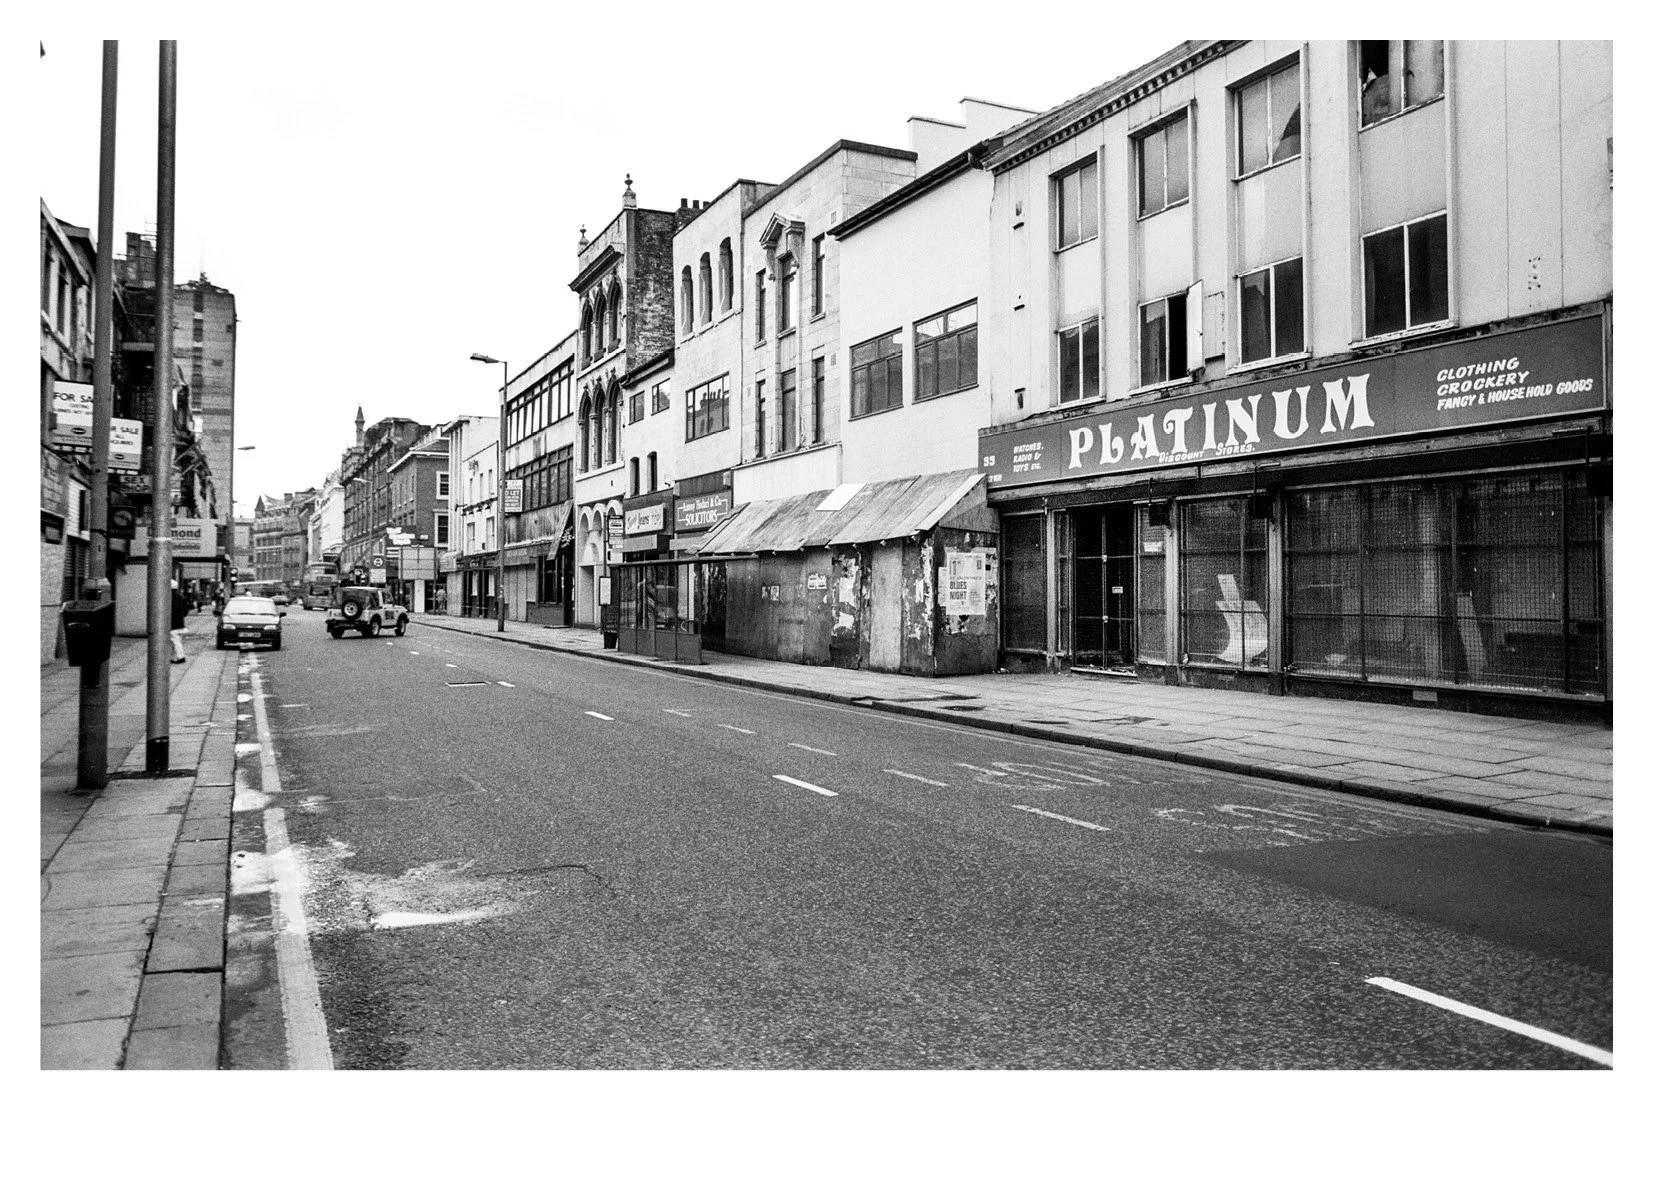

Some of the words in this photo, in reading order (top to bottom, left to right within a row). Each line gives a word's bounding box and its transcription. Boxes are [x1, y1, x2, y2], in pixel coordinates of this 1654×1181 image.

[1436, 357, 1520, 382] CLOTHING
[1436, 370, 1530, 396] CROCKERY
[53, 391, 75, 402] FOR
[1436, 394, 1477, 411] FANCY
[1477, 392, 1486, 404] &
[1556, 378, 1594, 395] GOODS
[1068, 373, 1375, 469] PLATINUM
[121, 426, 140, 436] SALE
[983, 455, 996, 468] 99
[1013, 454, 1033, 464] RADIO
[1013, 463, 1030, 473] TOYS
[685, 509, 718, 526] SOLICITORS
[949, 580, 967, 590] BLUES
[949, 591, 967, 600] NIGHT
